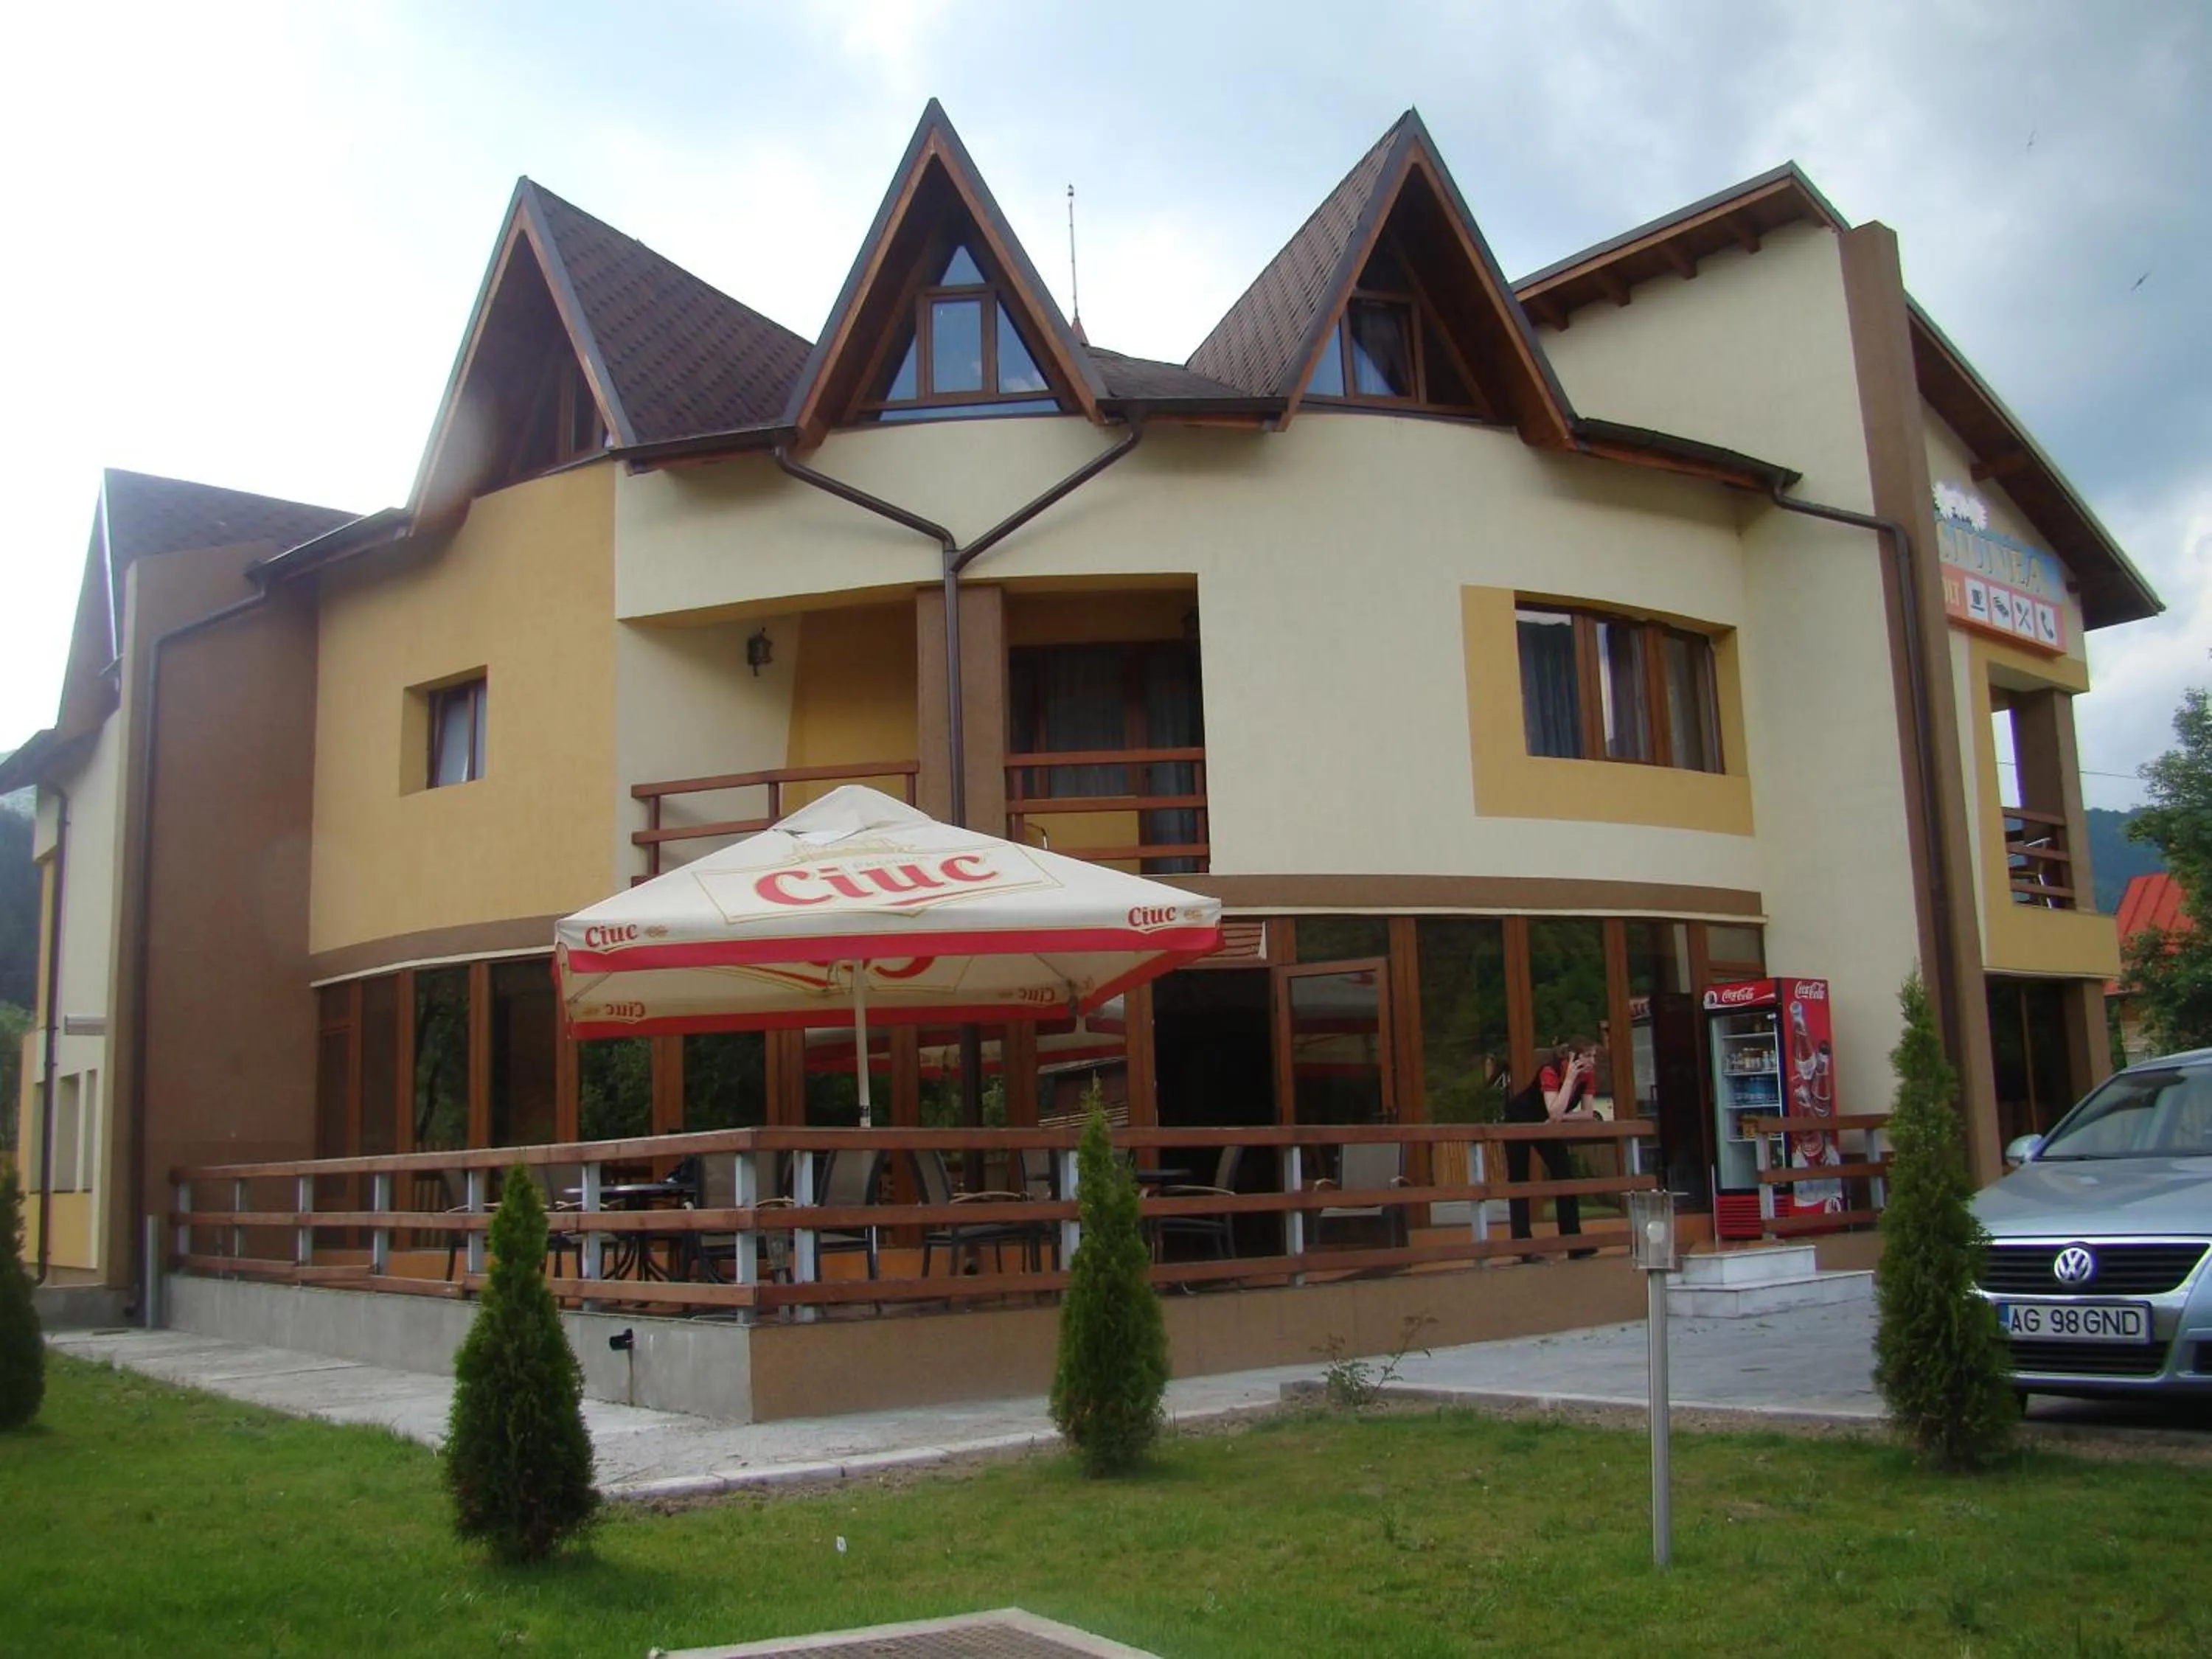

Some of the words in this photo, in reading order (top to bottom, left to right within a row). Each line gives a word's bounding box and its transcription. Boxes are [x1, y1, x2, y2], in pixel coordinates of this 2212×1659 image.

[754, 855, 998, 905] Ciuc
[1127, 906, 1177, 927] Ciuc
[585, 924, 639, 947] Ciuc
[2011, 1308, 2041, 1333] AG
[2050, 1309, 2079, 1334] 98
[2083, 1309, 2141, 1336] GND
